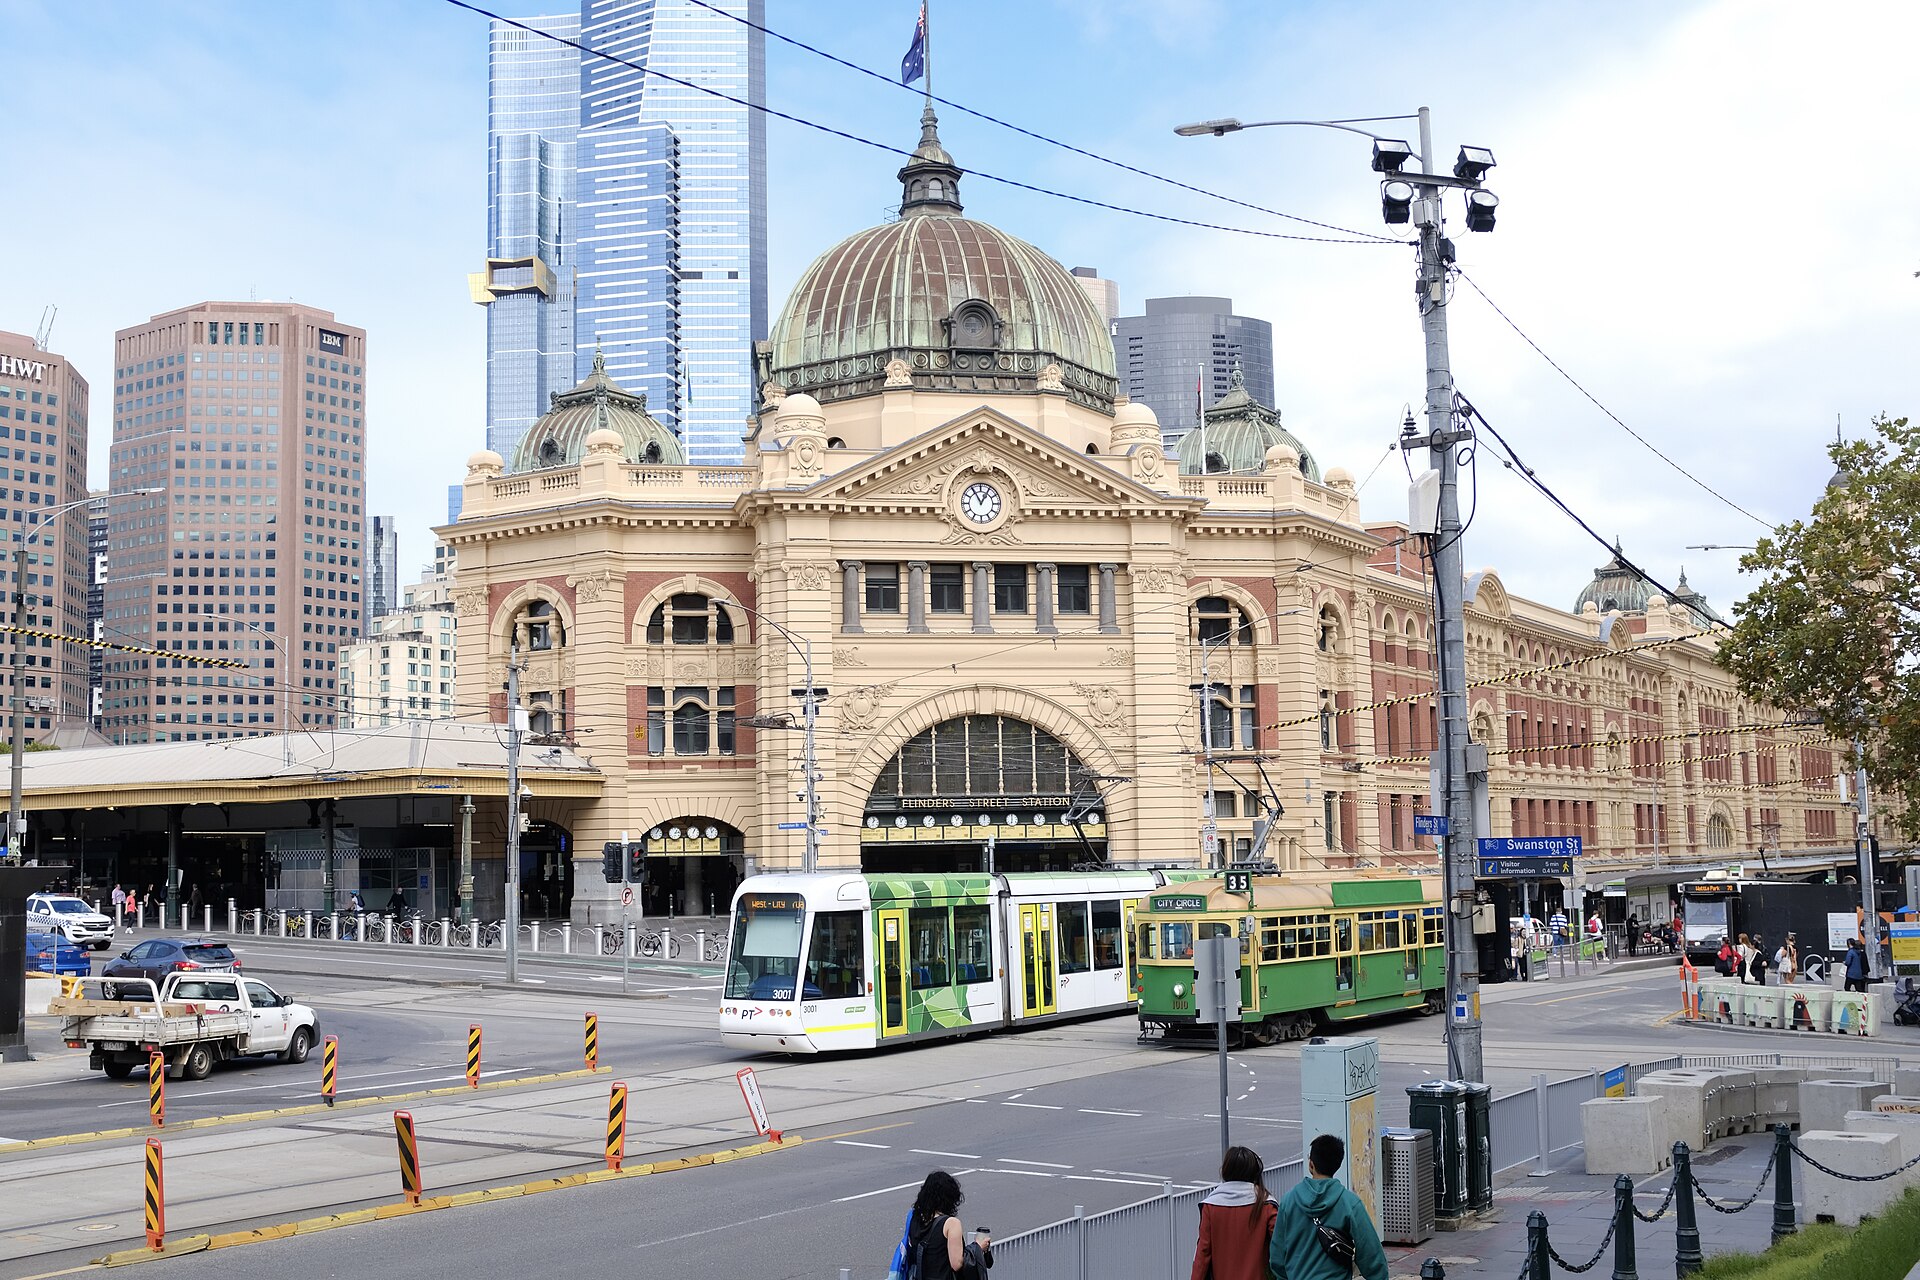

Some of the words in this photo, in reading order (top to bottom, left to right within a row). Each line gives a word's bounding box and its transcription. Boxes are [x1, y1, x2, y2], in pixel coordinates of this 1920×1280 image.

[322, 333, 341, 347] IBM
[1, 356, 46, 380] HWT
[902, 798, 955, 808] FLINDERS
[969, 798, 1010, 807] STREET
[1022, 797, 1070, 807] STATION
[1507, 839, 1563, 850] Swanston
[1566, 838, 1578, 849] St
[1229, 875, 1247, 890] 35
[1157, 899, 1173, 907] CITY
[1176, 899, 1201, 907] CIRCLE
[772, 989, 792, 1000] 3001
[803, 1005, 817, 1013] 3001
